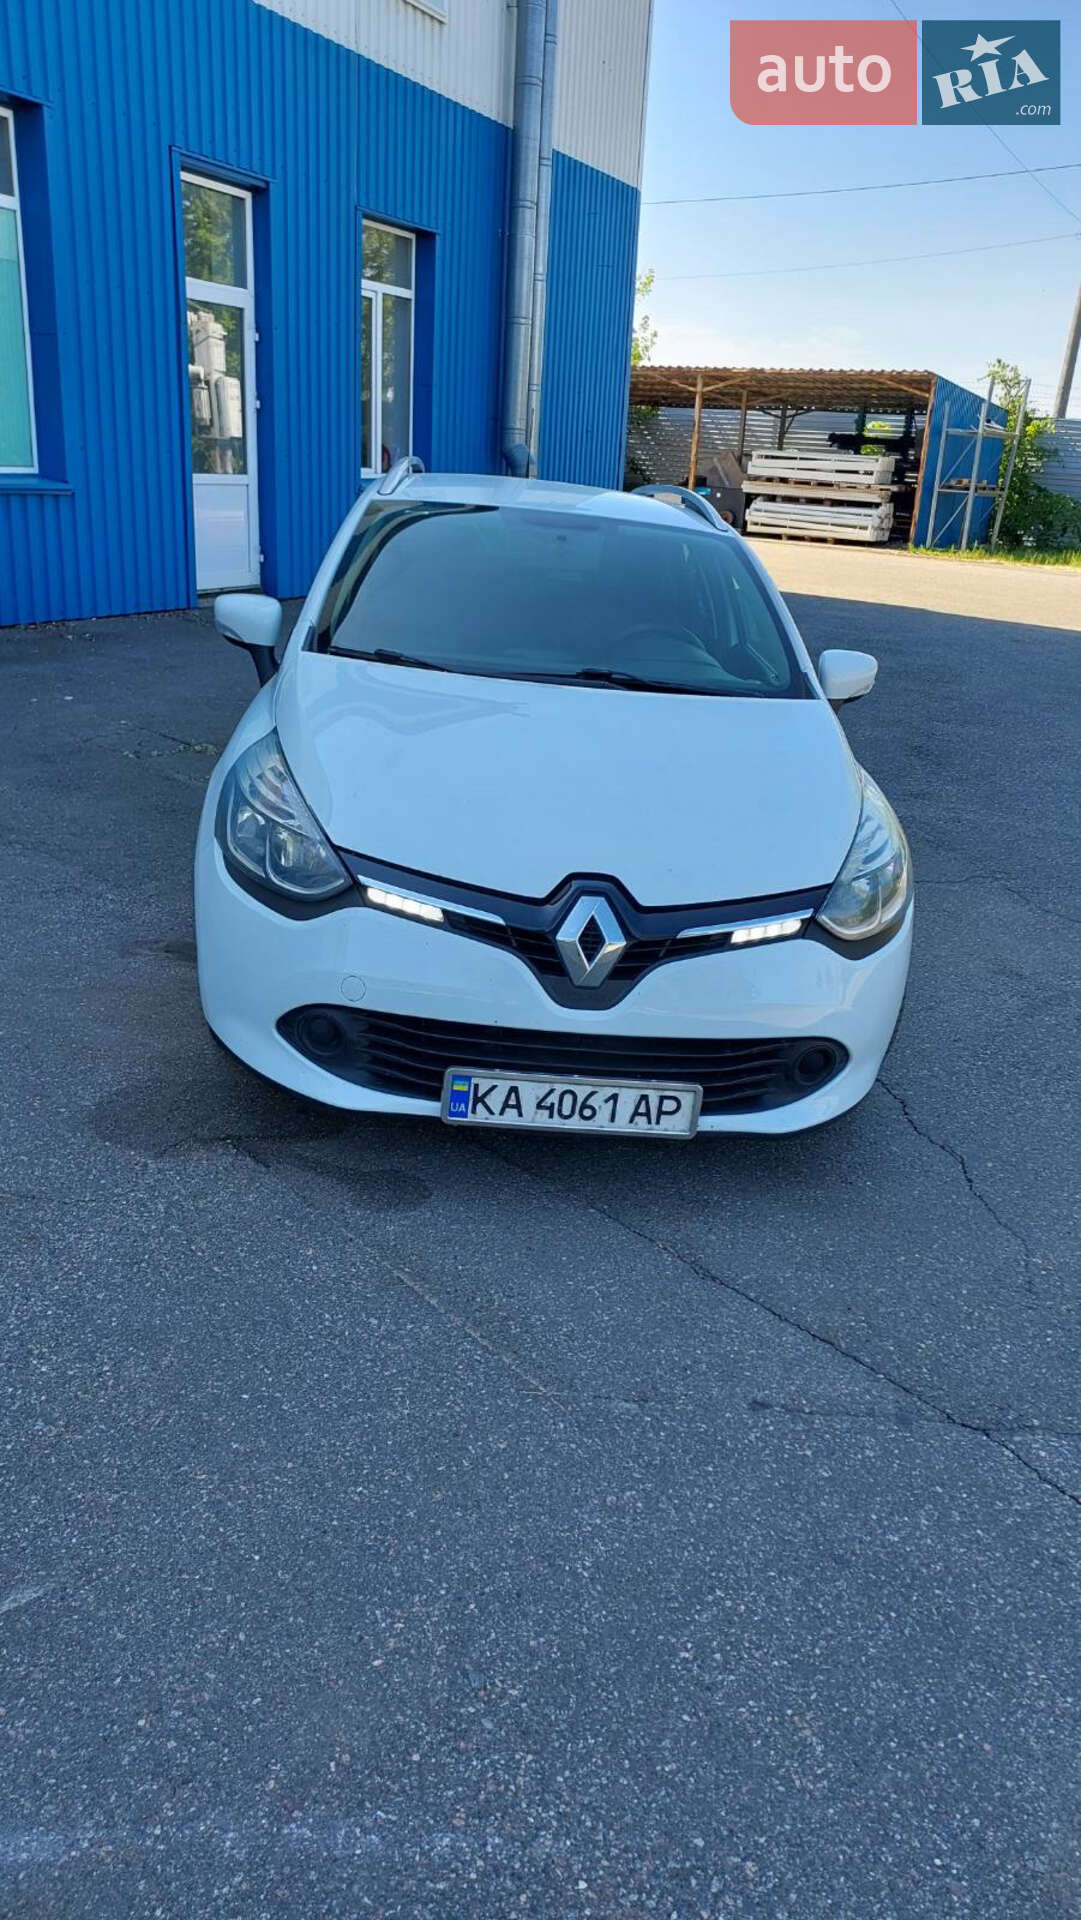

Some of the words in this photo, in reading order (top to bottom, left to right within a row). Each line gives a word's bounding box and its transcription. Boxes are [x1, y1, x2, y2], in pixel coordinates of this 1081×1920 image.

[450, 1103, 467, 1114] UA
[470, 1083, 524, 1118] KA
[535, 1088, 620, 1123] 4061
[629, 1094, 682, 1125] AP
